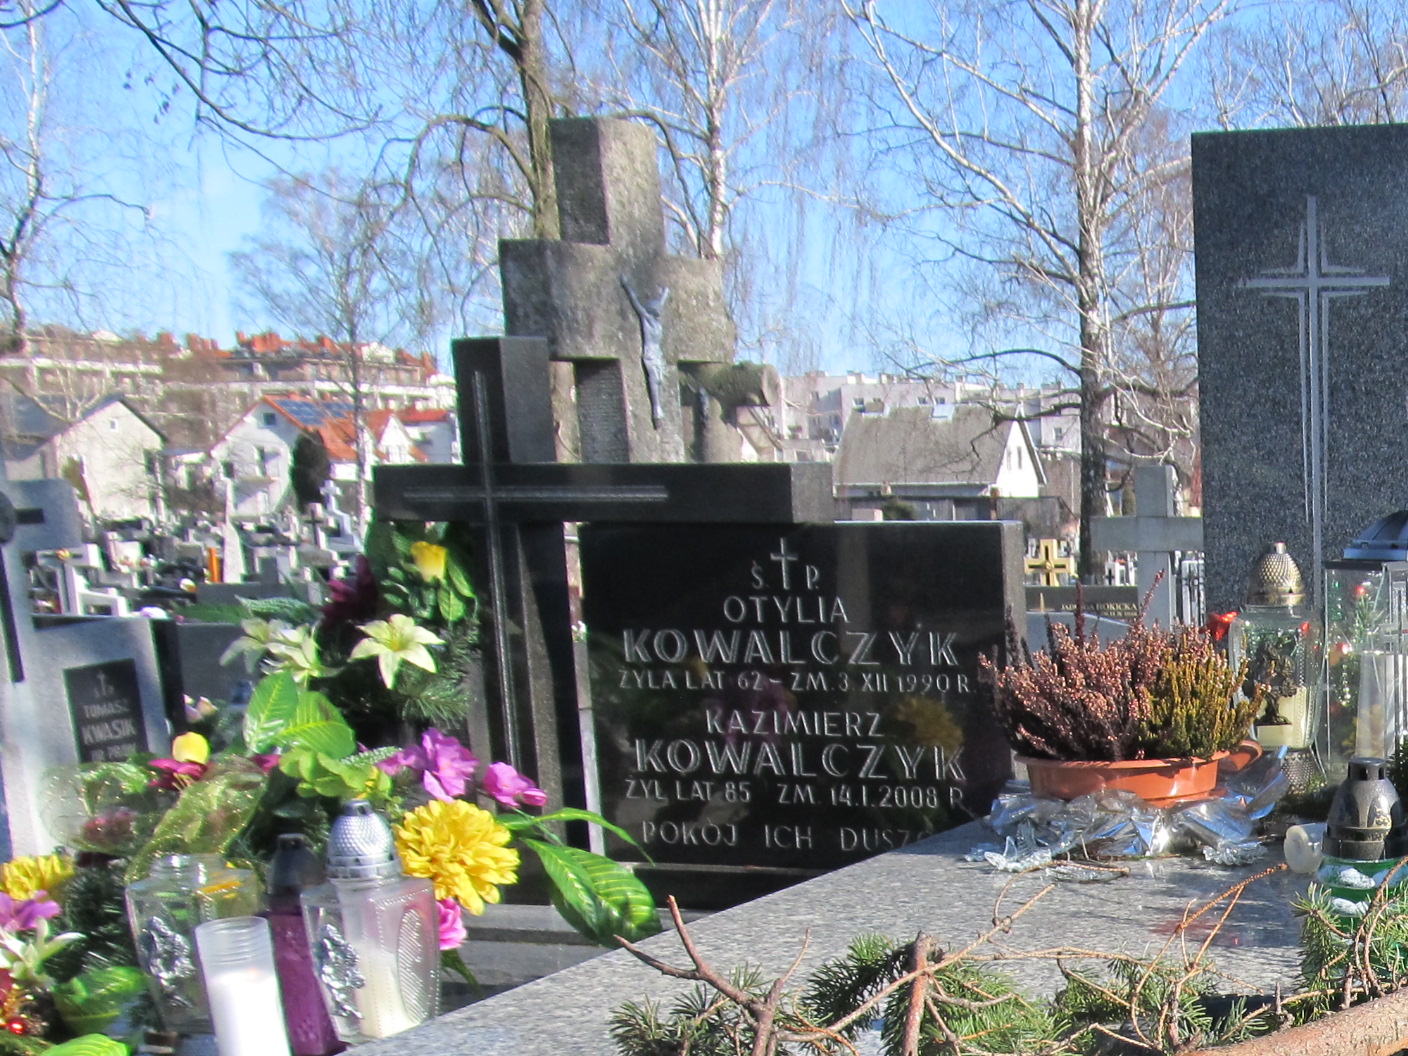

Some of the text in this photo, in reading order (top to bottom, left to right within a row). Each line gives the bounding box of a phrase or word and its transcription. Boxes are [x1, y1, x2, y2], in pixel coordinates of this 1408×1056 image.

[724, 595, 850, 624] OTYLIA
[623, 628, 960, 667] KOWALCZYK
[685, 670, 725, 690] LAT
[737, 671, 765, 691] 62
[898, 673, 949, 693] 1990
[706, 708, 885, 737] KAZIMIERZ
[635, 738, 968, 781] KOWALCZYK
[676, 780, 714, 801] LAT
[725, 781, 751, 803] 85
[765, 823, 813, 850] ICH
